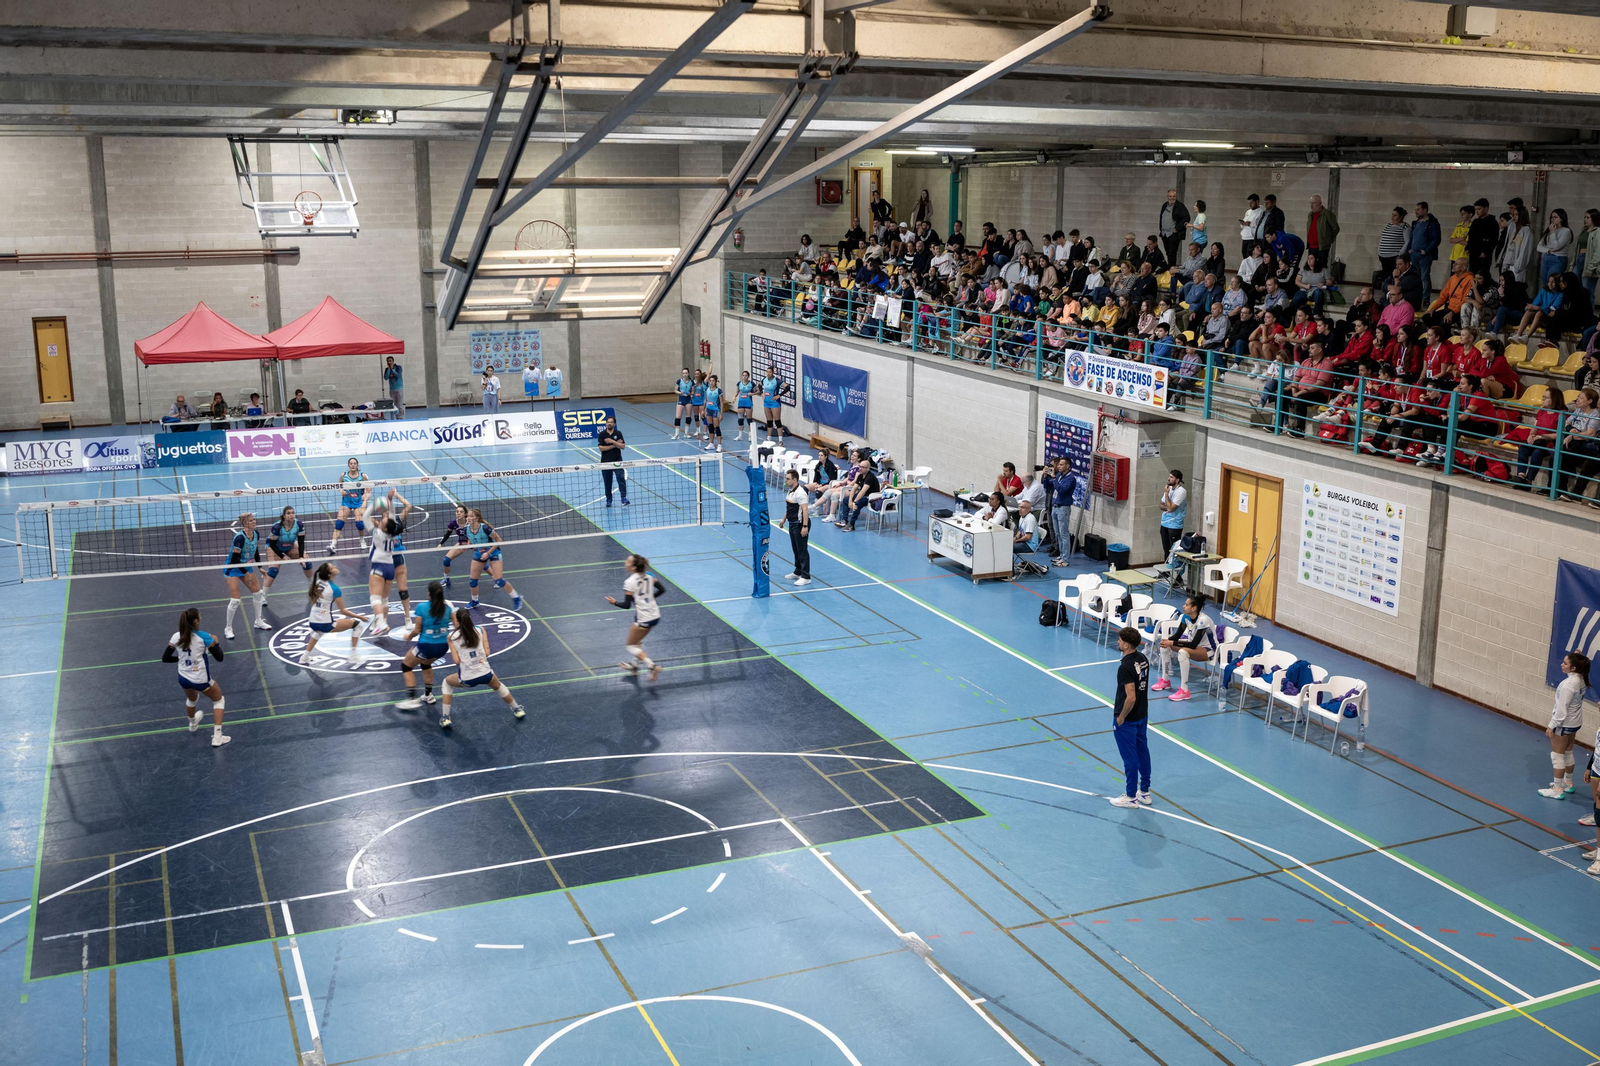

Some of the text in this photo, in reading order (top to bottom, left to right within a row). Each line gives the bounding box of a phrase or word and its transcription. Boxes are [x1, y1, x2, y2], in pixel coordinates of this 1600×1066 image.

[1087, 362, 1152, 387] FASE DE ASCENSO
[812, 378, 828, 390] XUNTA
[818, 391, 837, 404] GALICIA
[562, 409, 607, 426] SER
[523, 422, 543, 430] Bello
[13, 440, 74, 462] MYG
[157, 441, 223, 460] juguettos
[13, 458, 74, 470] asesores
[111, 453, 139, 465] sport
[501, 469, 534, 477] VOLEIBOL
[534, 466, 564, 474] OURENSE
[276, 485, 311, 493] VOLEIBOL
[311, 483, 344, 491] OURENSE
[1327, 490, 1379, 512] BURGAS VOLEIBOL
